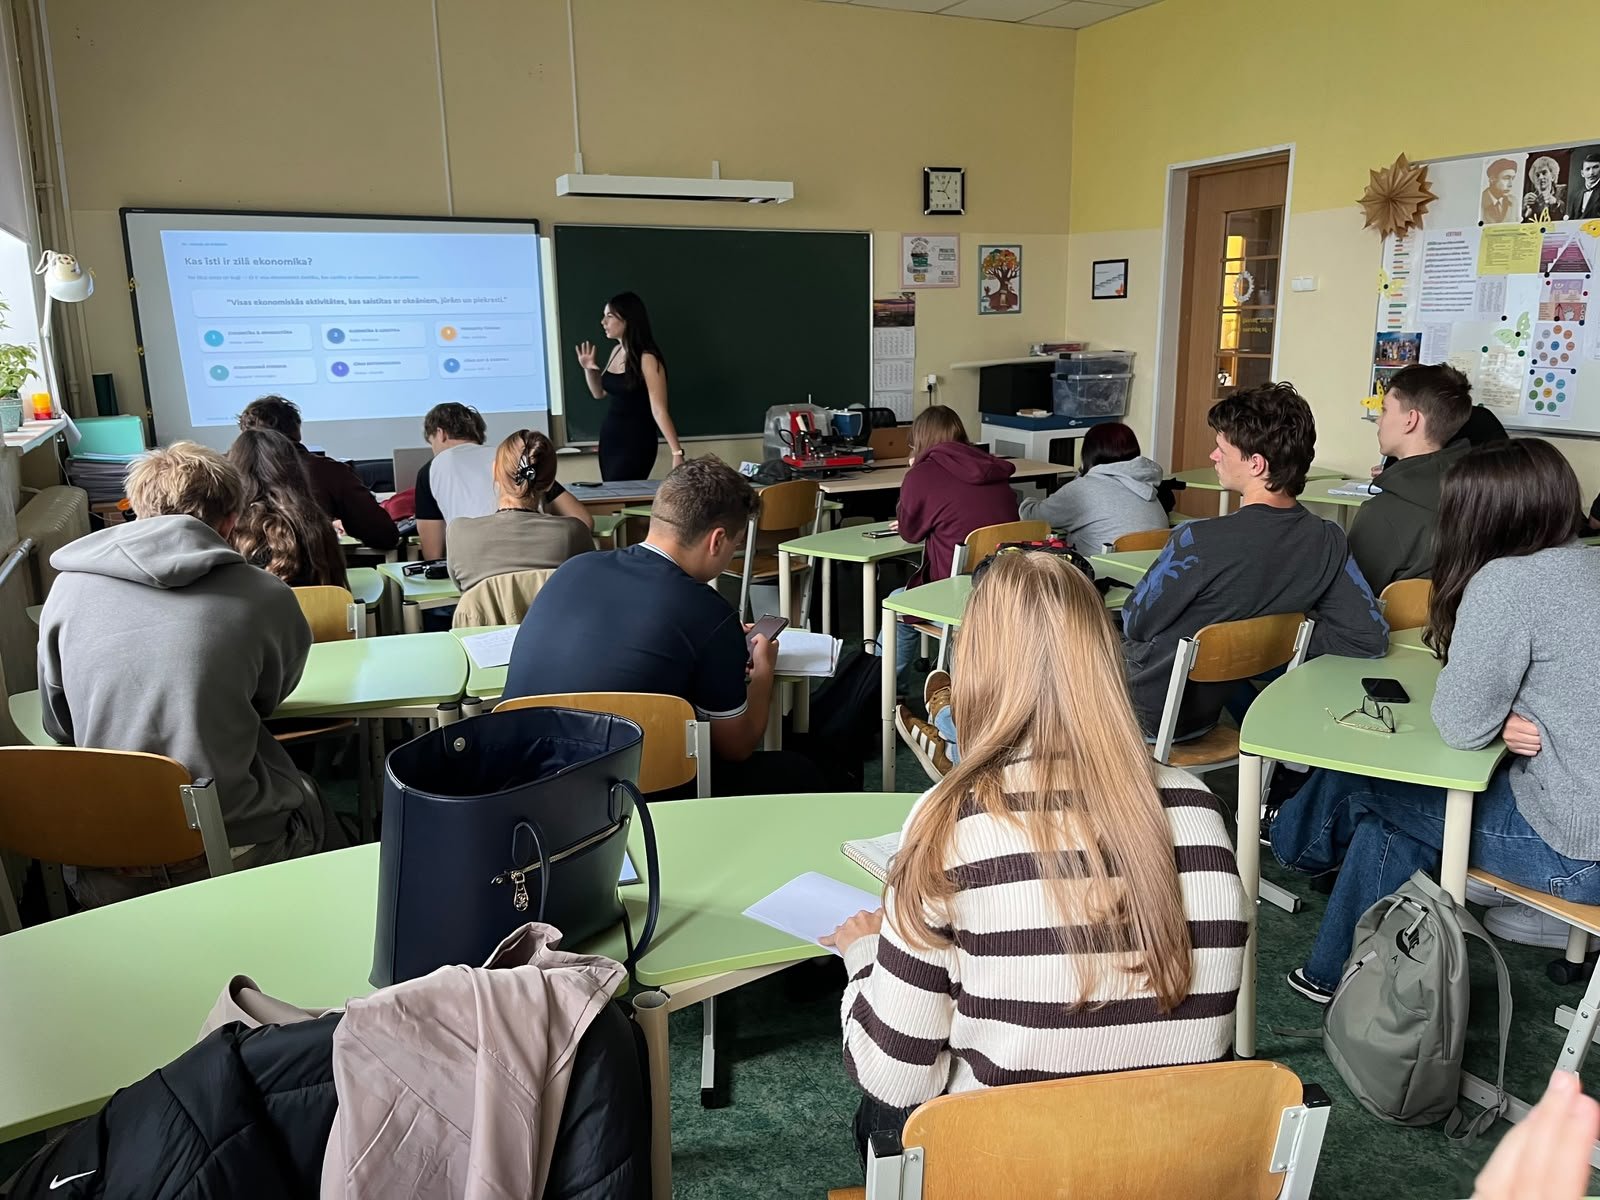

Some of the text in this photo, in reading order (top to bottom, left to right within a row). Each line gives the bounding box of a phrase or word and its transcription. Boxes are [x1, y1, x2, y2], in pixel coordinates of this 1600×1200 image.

[184, 257, 203, 266] Kas
[223, 257, 230, 266] ir
[253, 257, 313, 267] ekonomika?
[348, 297, 361, 306] kas
